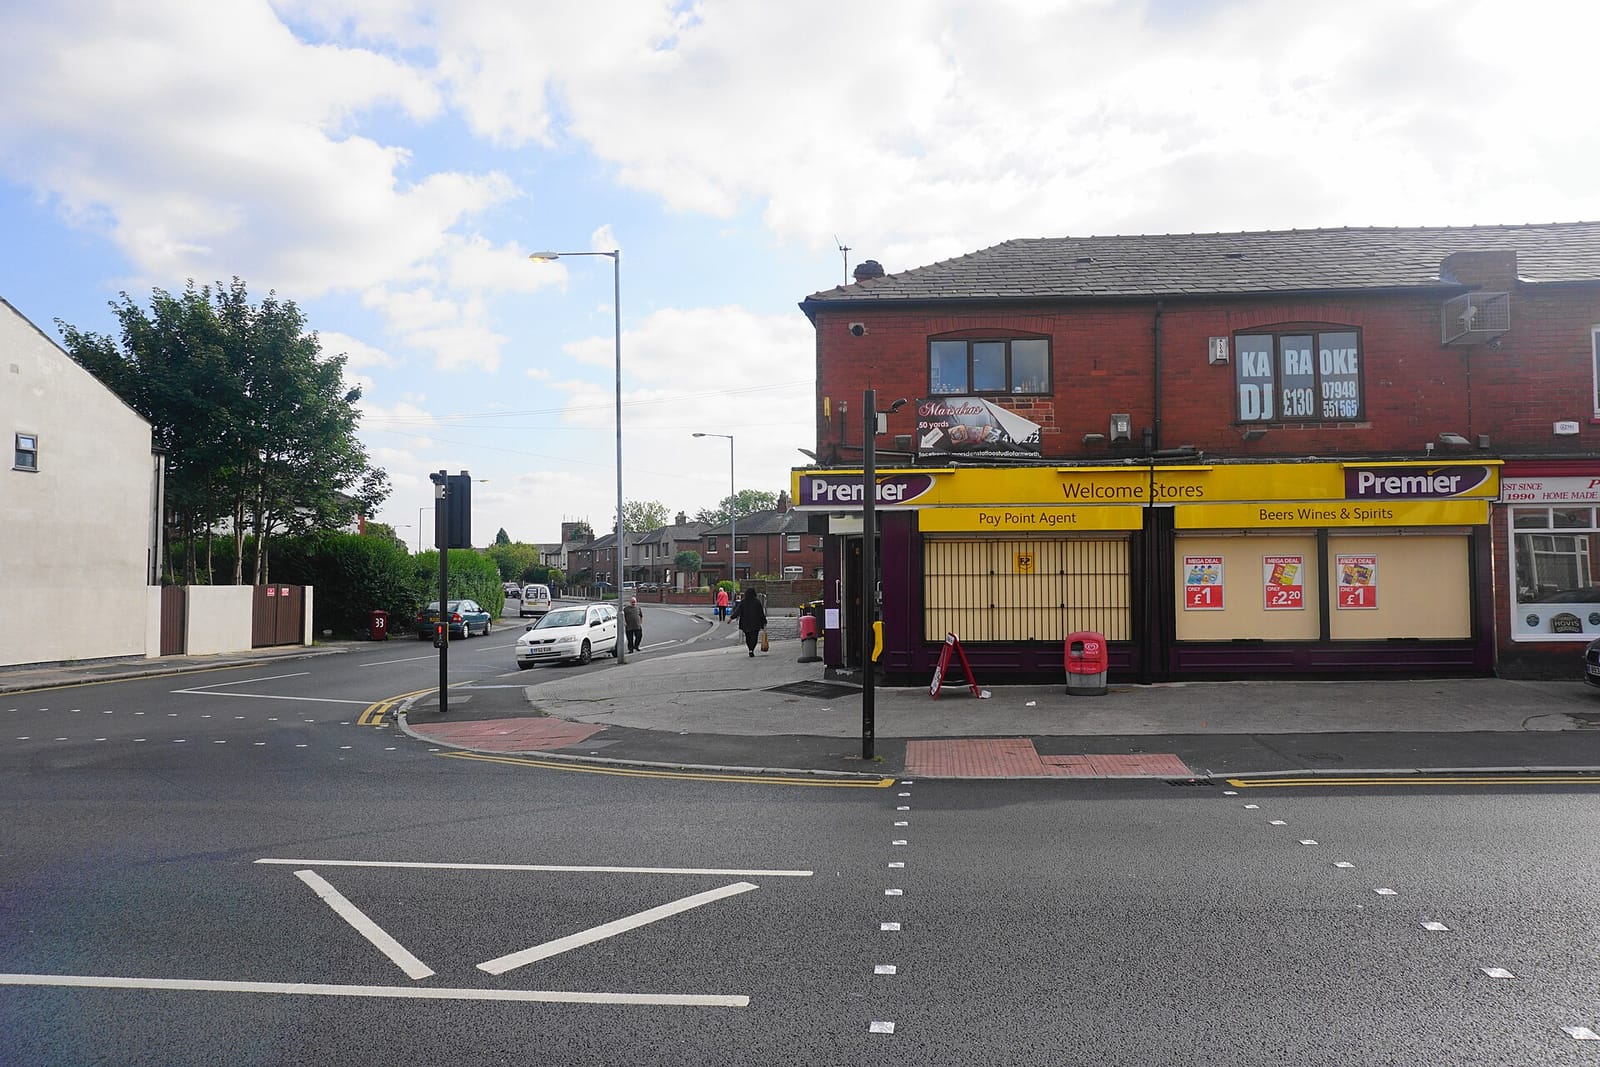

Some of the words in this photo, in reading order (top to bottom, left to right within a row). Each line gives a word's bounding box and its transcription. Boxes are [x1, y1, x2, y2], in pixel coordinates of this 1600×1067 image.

[1241, 351, 1271, 377] KA
[1285, 349, 1313, 375] RA
[1319, 348, 1358, 376] OKE
[1322, 380, 1356, 399] 07948
[1239, 383, 1273, 420] DJ
[1283, 388, 1314, 416] £130
[919, 421, 928, 429] 50
[929, 420, 949, 430] yards
[1062, 482, 1143, 498] Welcome
[1149, 482, 1204, 498] Stores
[1358, 470, 1461, 494] Premier
[1518, 482, 1543, 491] SINCE
[1542, 491, 1568, 500] HOME
[1571, 491, 1598, 500] MADE
[979, 512, 1001, 526] Pay
[1004, 512, 1035, 524] Point
[1039, 512, 1077, 526] Agent
[1259, 509, 1294, 520] Beers
[1298, 508, 1337, 520] Wines
[1340, 508, 1350, 520] &
[1353, 507, 1393, 522] Spirits
[1194, 587, 1211, 604] £1
[1346, 588, 1364, 605] £1
[375, 617, 384, 628] 33
